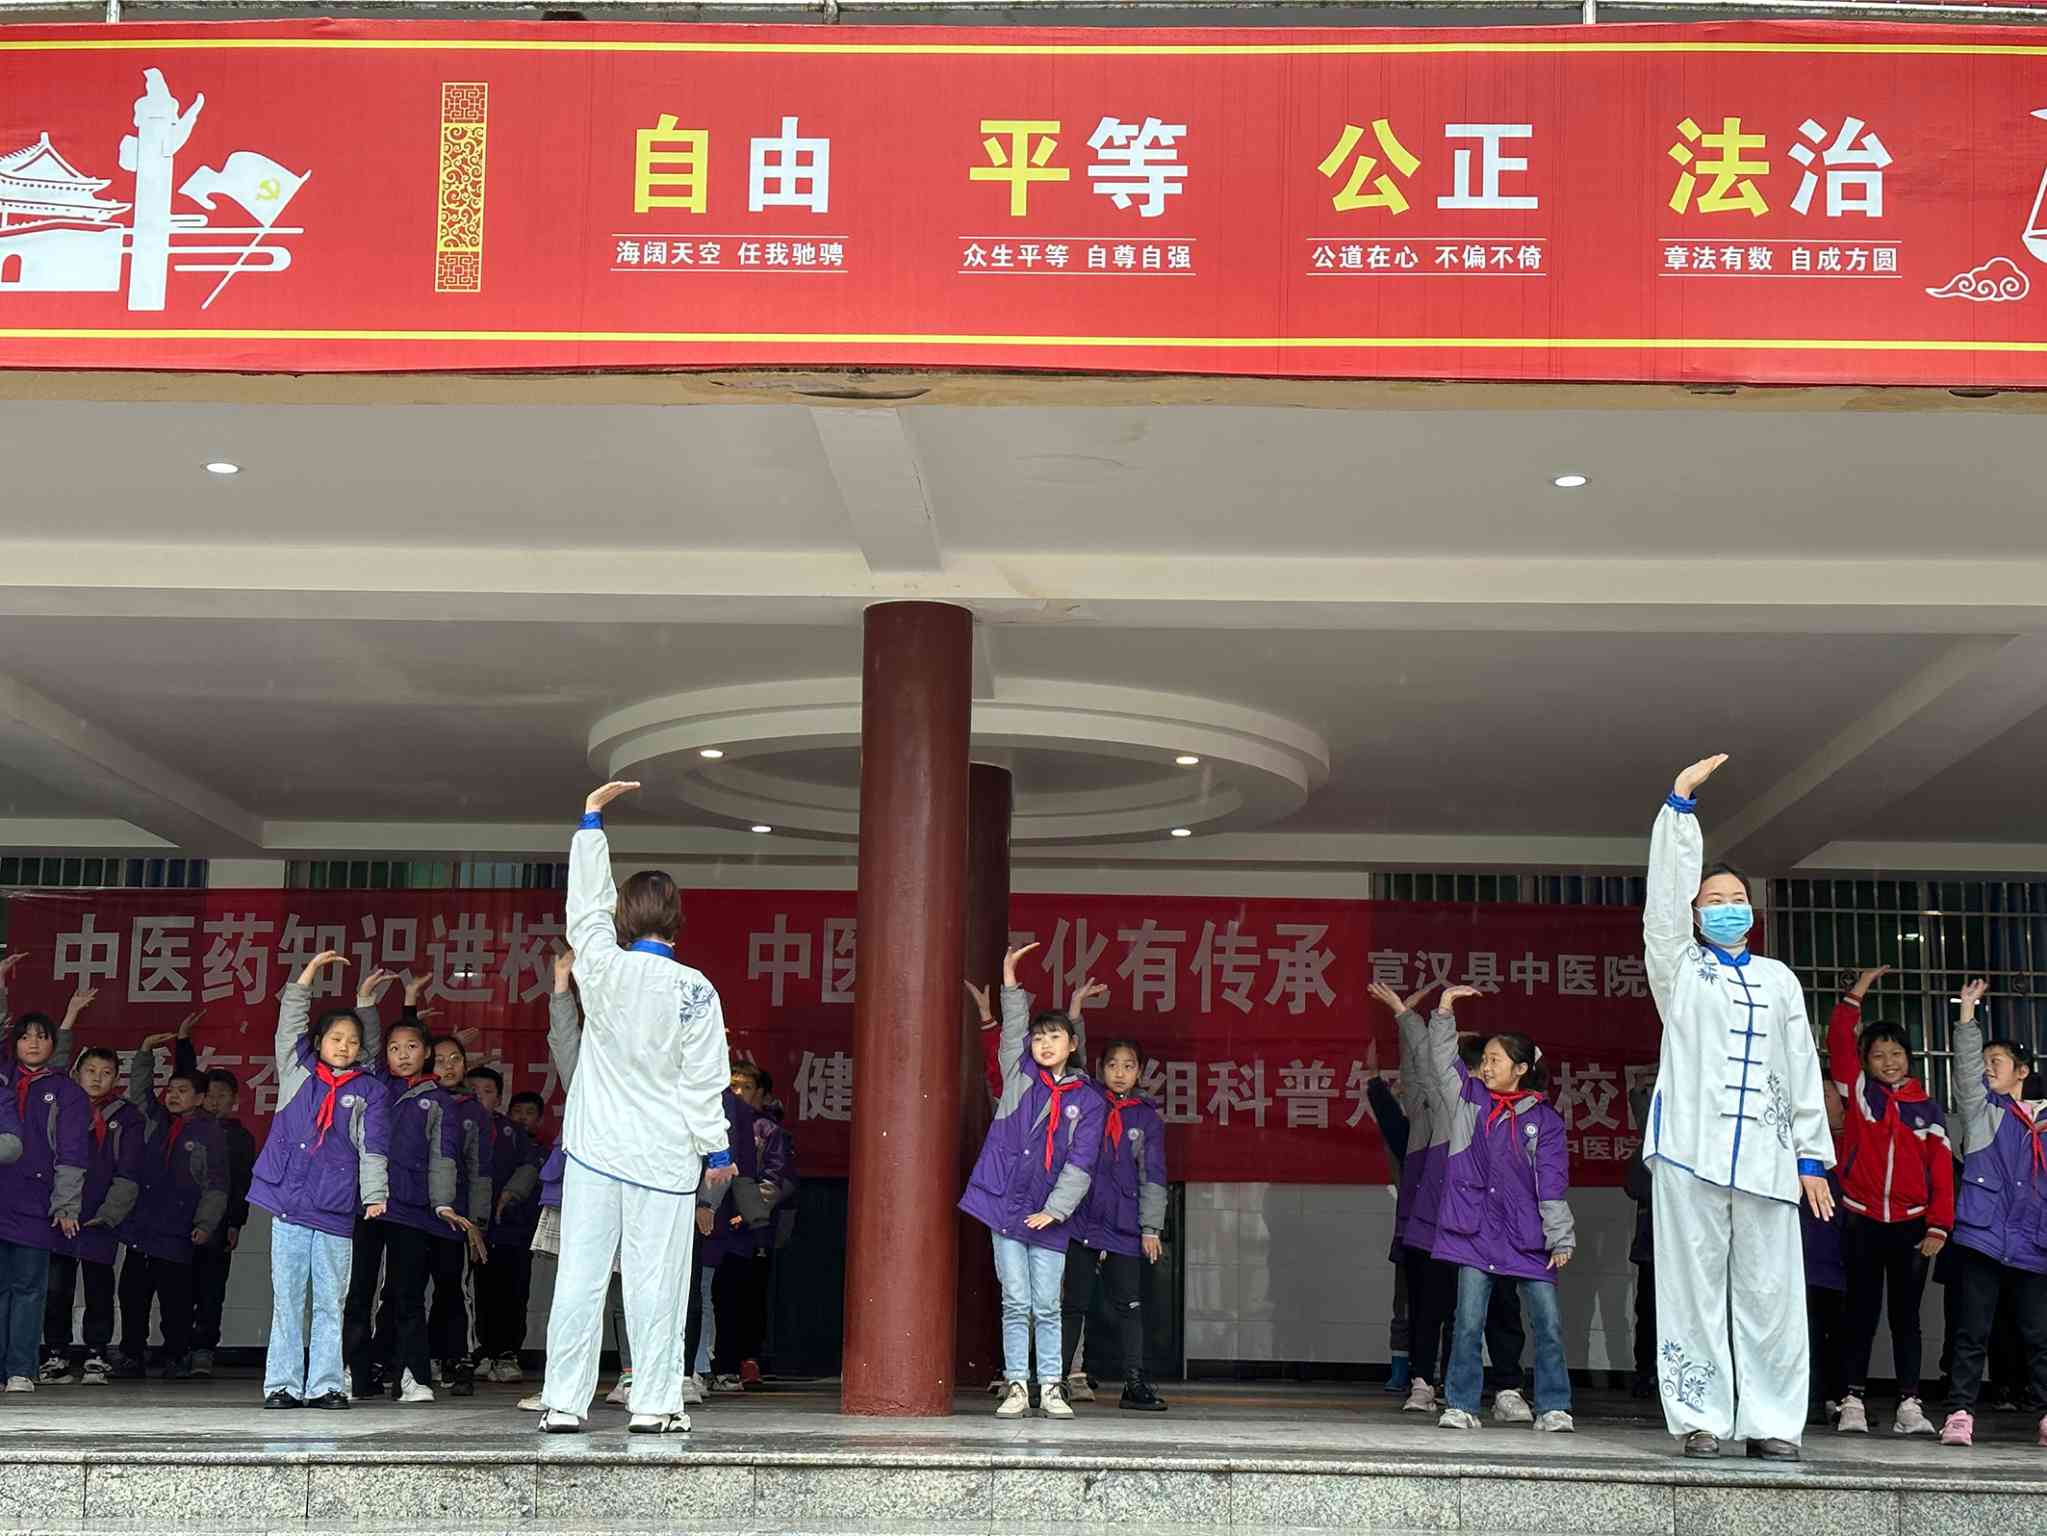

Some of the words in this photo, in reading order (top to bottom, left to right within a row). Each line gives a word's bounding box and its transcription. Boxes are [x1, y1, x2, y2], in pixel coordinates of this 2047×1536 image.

[634, 113, 830, 214] 自由
[969, 116, 1188, 218] 平等
[1317, 118, 1539, 215] 公正
[1667, 116, 1894, 218] 法治
[615, 240, 721, 266] 海阔天空
[737, 241, 846, 267] 任我驰骋
[961, 243, 1070, 268] 众生平等
[1087, 244, 1192, 269] 自尊自强
[1312, 244, 1419, 269] 公道在心
[1434, 244, 1543, 270] 不偏不倚
[1662, 245, 1774, 271] 章法有数
[1790, 246, 1898, 272] 自成方圆
[1008, 917, 1337, 1015] 化有传承
[1367, 949, 1648, 998] 宣汉县中医院
